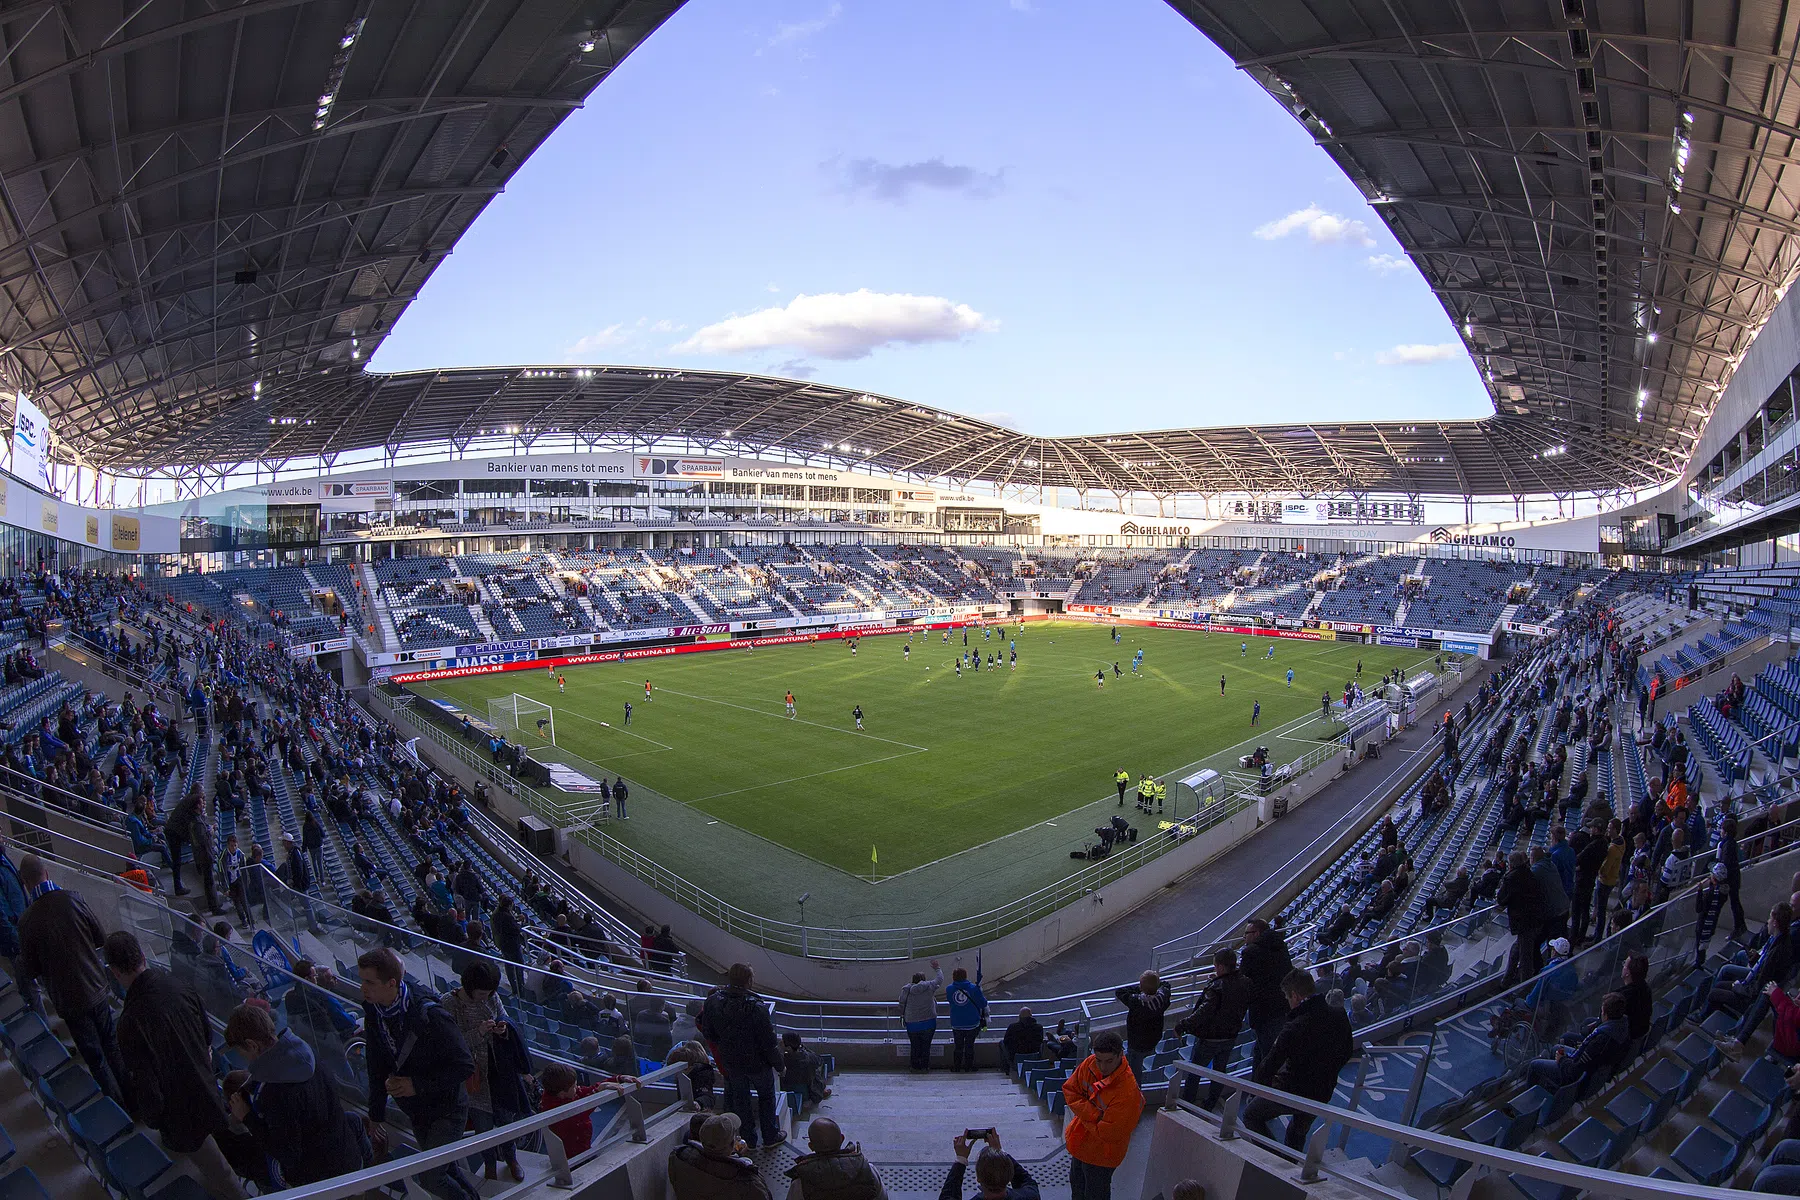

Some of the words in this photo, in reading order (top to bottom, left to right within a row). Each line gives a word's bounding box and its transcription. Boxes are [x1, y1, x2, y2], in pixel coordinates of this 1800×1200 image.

[487, 462, 528, 473] Bankier
[530, 464, 548, 473] van
[551, 464, 579, 473] mens
[581, 463, 596, 473] tot
[598, 464, 625, 474] mens
[638, 458, 680, 475] VDK
[681, 464, 723, 472] SPAARBANK
[732, 467, 764, 478] Bankier
[782, 472, 803, 480] mens
[805, 472, 816, 480] tot
[817, 473, 838, 482] mens
[261, 487, 313, 497] www.vdk.be
[355, 485, 389, 493] SPAARBANK
[119, 524, 138, 541] telenet
[1139, 526, 1190, 535] GHELAMCO
[1233, 527, 1247, 535] WE
[1249, 527, 1285, 536] CREATE
[1287, 528, 1305, 536] THE
[1307, 528, 1344, 537] FUTURE
[1347, 529, 1378, 538] TODAY
[1453, 533, 1515, 547] GHELAMCO
[1331, 622, 1362, 632] Jupiler
